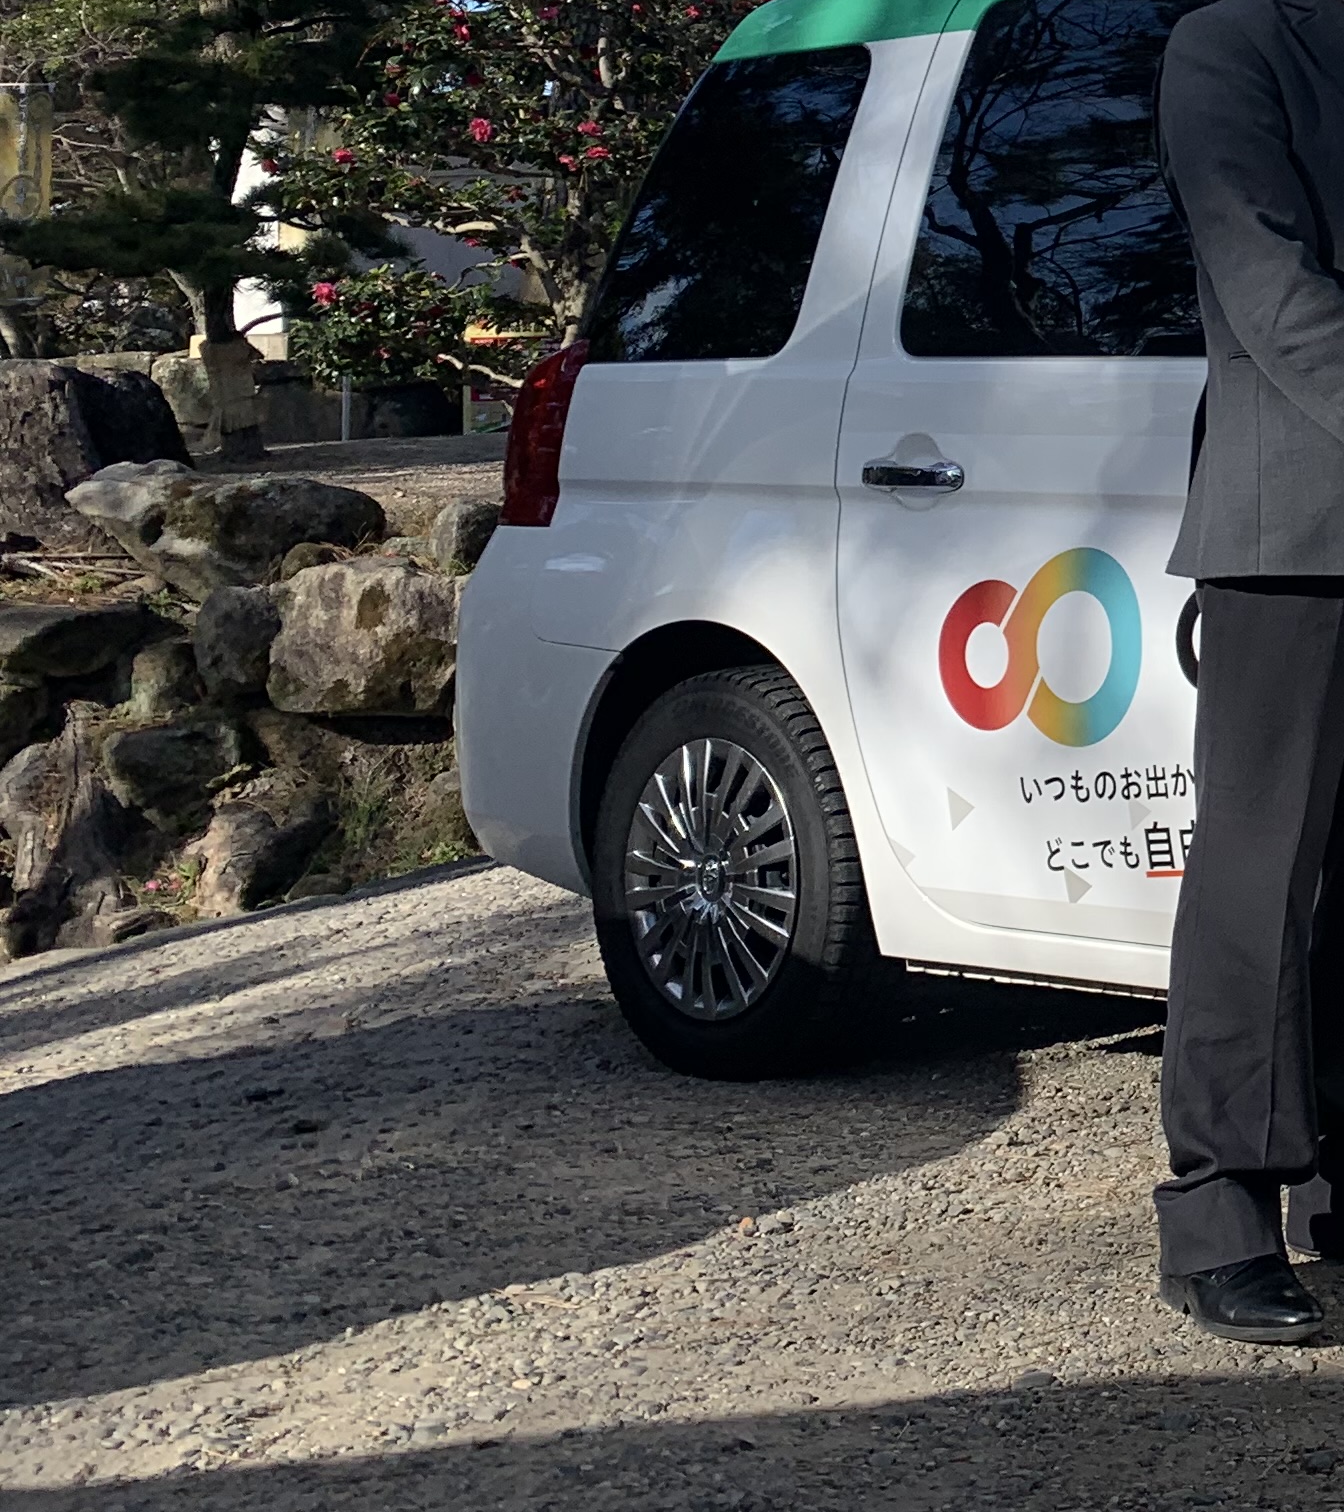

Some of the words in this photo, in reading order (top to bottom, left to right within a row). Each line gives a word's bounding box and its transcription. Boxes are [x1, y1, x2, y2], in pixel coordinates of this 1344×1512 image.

[1020, 764, 1196, 804] いつものお出か
